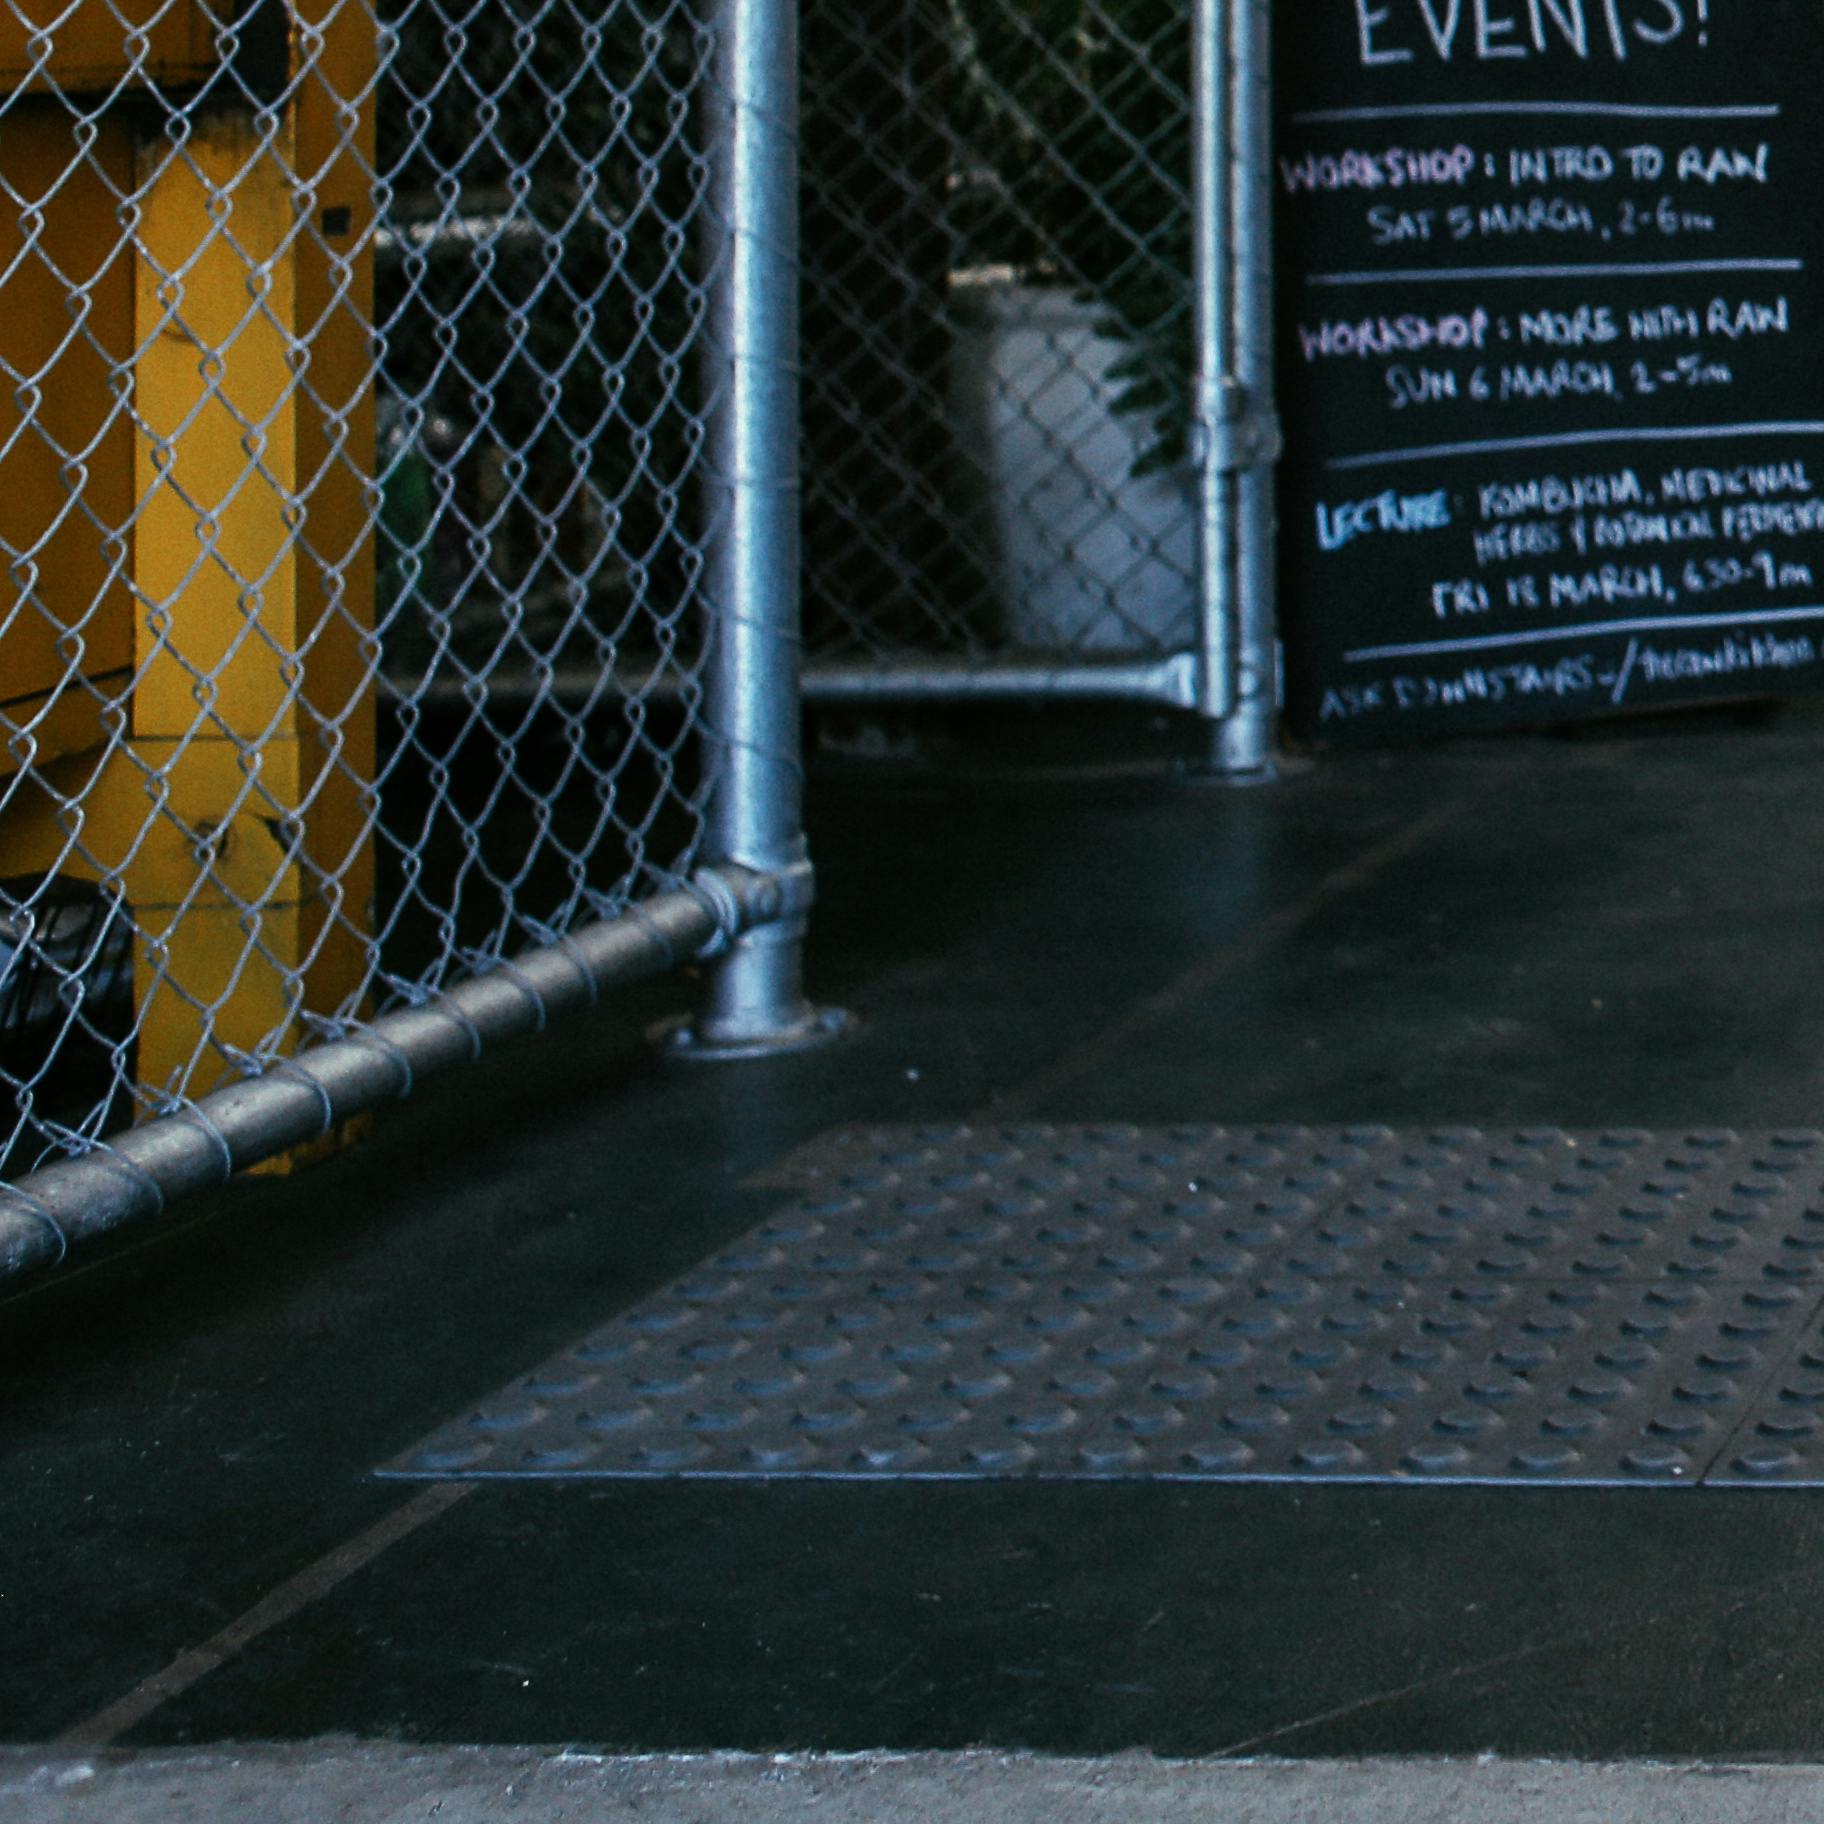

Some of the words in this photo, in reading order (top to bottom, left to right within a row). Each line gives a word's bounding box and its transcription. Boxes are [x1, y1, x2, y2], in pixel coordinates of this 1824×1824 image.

[1509, 144, 1614, 186] INTRO
[1619, 144, 1665, 182] TO
[1677, 141, 1768, 185] RAW
[1366, 204, 1433, 246] SAT
[1519, 303, 1619, 348] MORE
[1706, 294, 1790, 342] RAW
